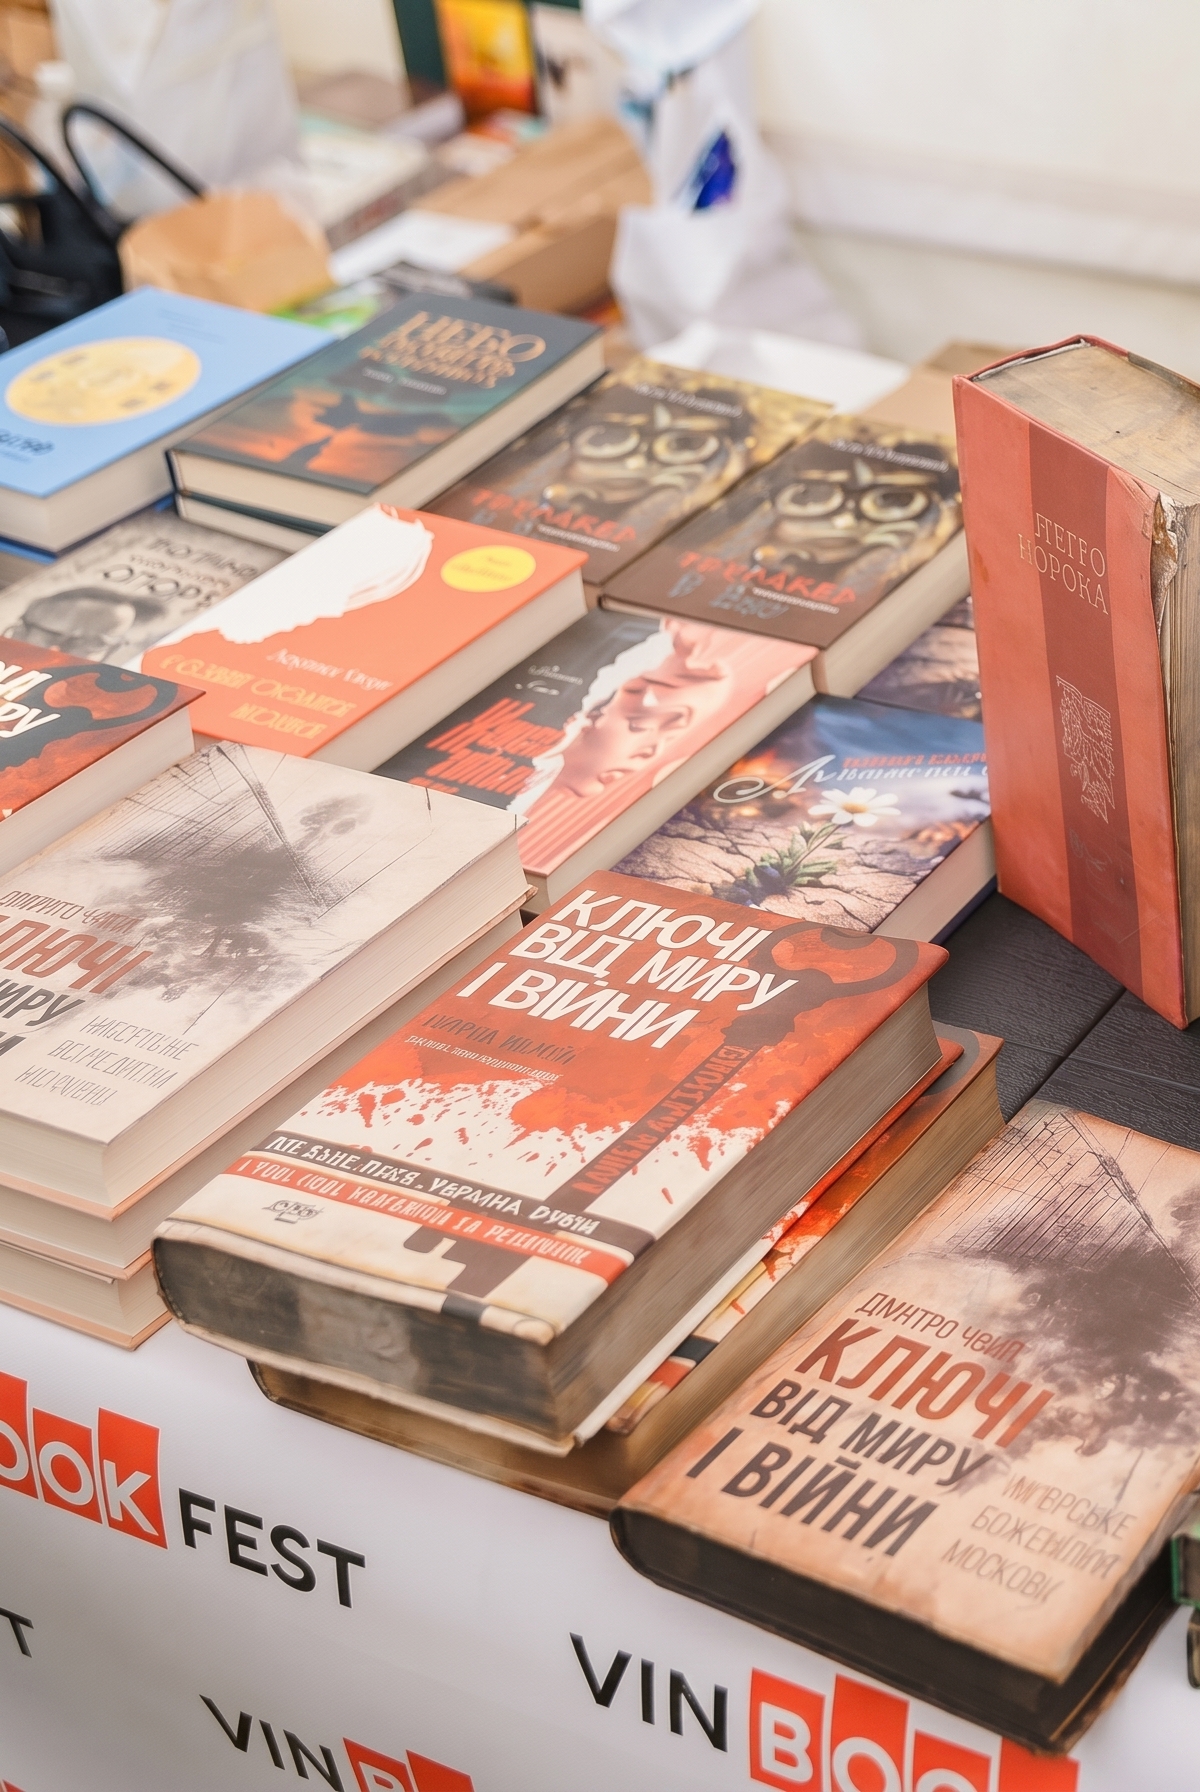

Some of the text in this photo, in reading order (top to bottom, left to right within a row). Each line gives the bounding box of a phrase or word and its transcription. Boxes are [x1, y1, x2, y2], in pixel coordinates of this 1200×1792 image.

[0, 915, 154, 994] ЛЮЧІ
[508, 921, 800, 1013] ВІД МИРУ
[550, 889, 773, 963] КЛЮЧІ
[456, 961, 701, 1049] І ВІЙНИ
[750, 1378, 995, 1488] ВІД МИРУ
[795, 1318, 1056, 1449] КЛЮЧІ
[686, 1427, 940, 1557] І ВІЙНИ
[178, 1488, 366, 1608] FEST
[199, 1694, 346, 1792] VIN
[570, 1632, 728, 1753] VIN
